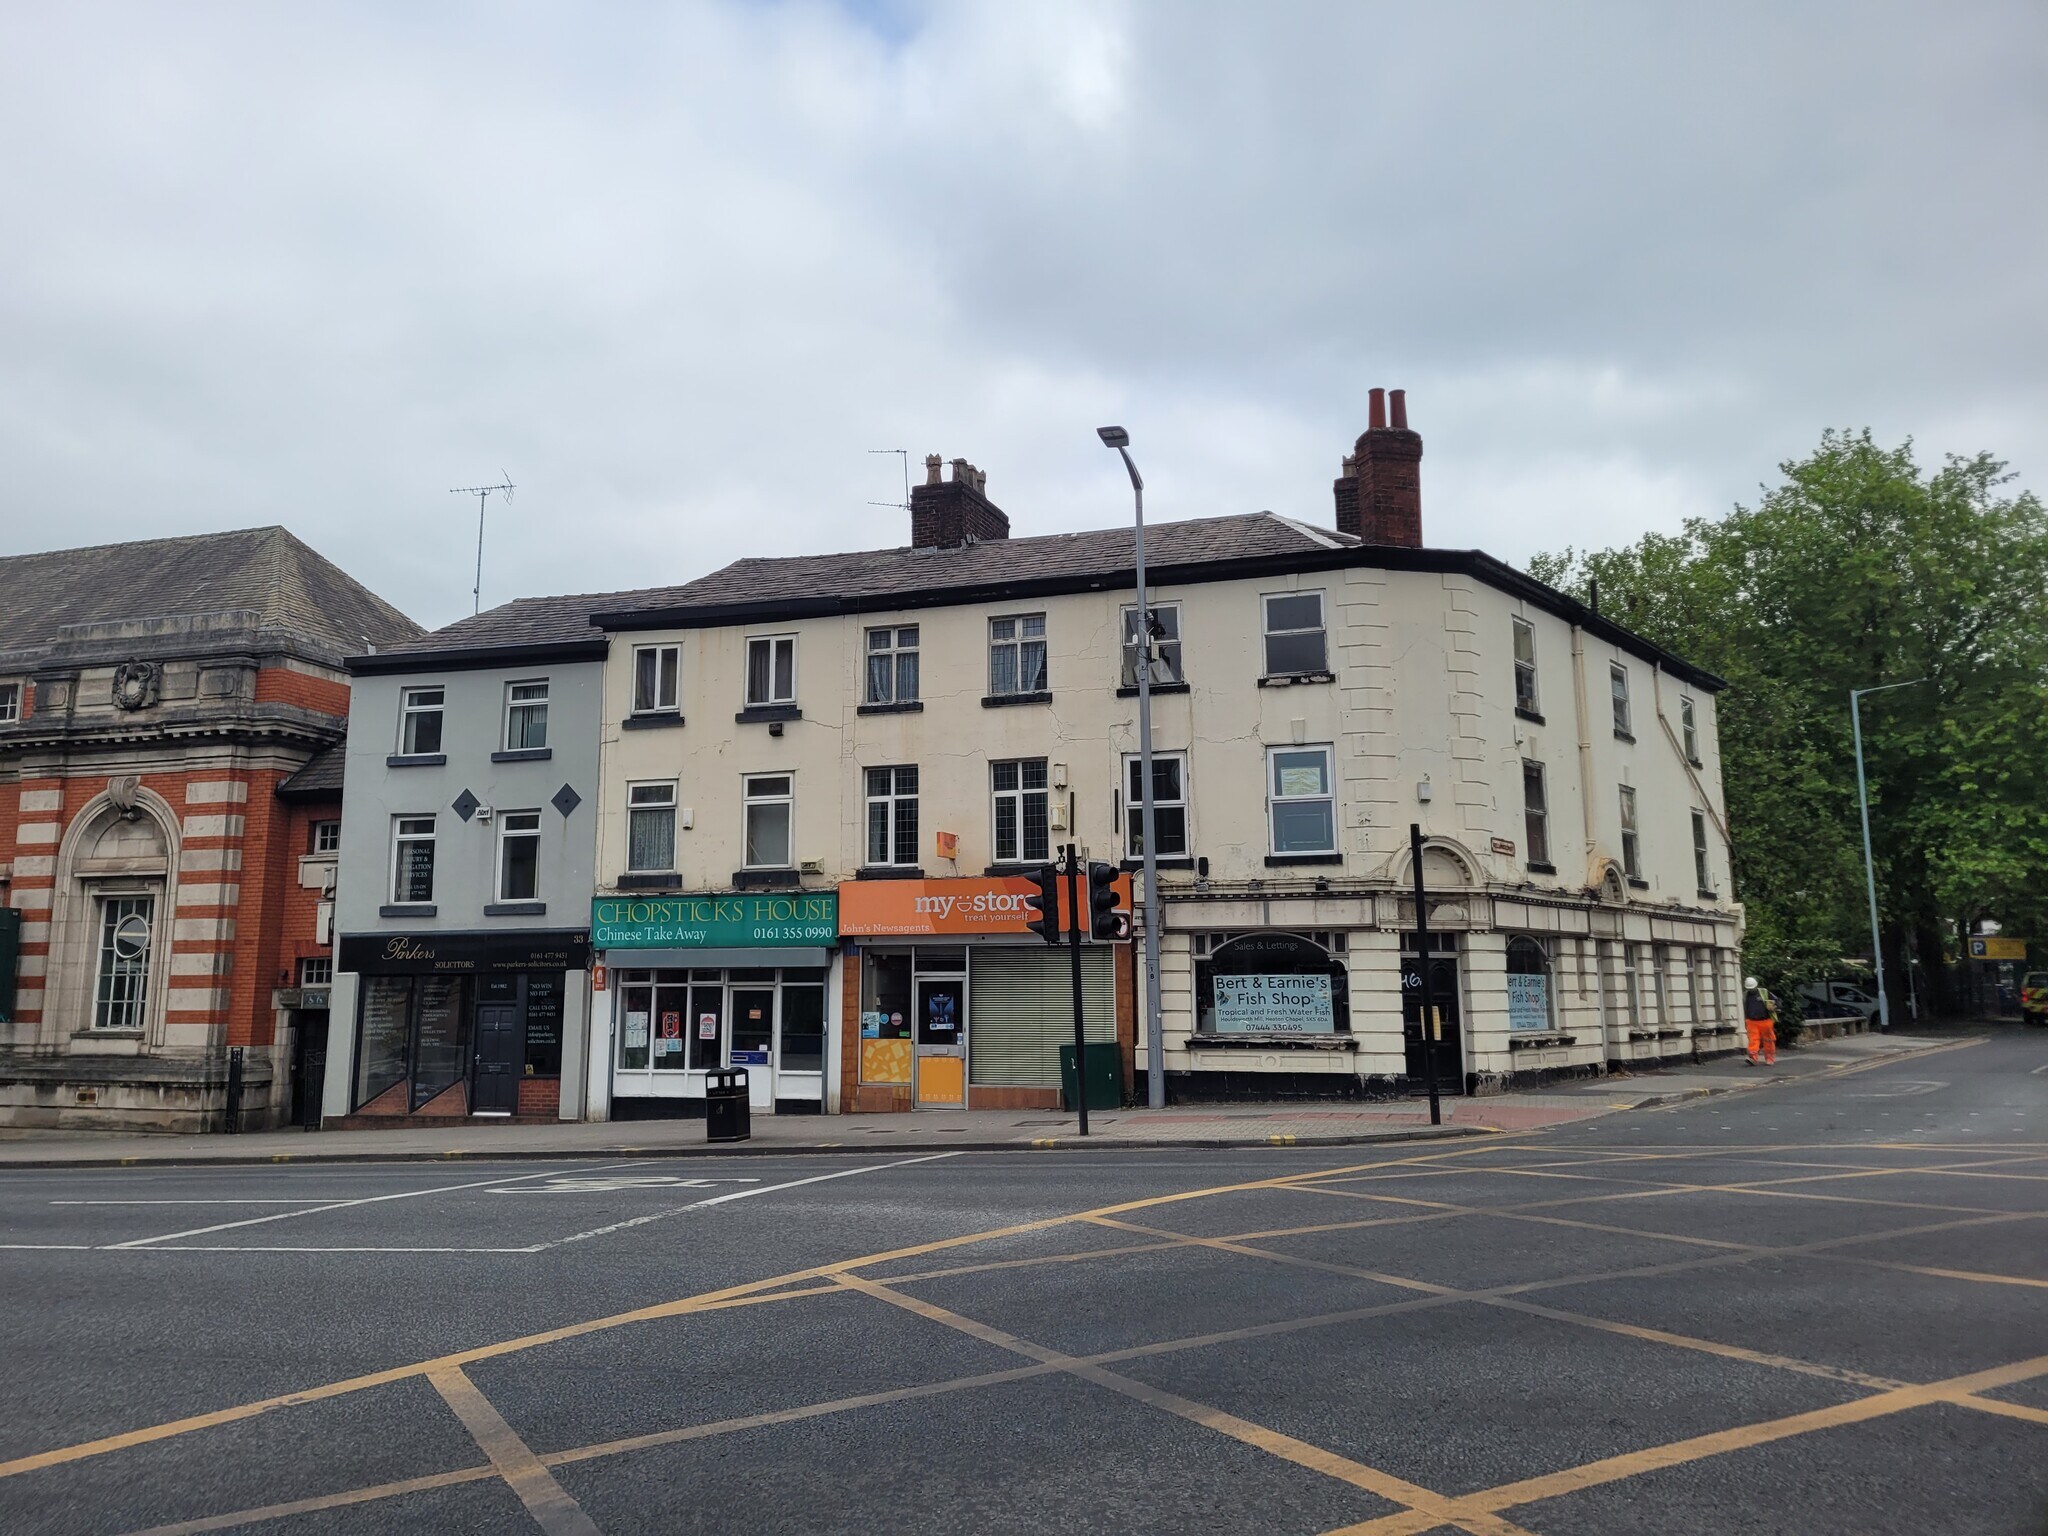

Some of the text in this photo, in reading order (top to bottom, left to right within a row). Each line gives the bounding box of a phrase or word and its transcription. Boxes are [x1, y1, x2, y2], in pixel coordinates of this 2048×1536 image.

[597, 899, 833, 924] CHOPSTICKS HOUSE
[965, 911, 1028, 922] treat yourself
[754, 926, 832, 938] 0161 355 0990
[841, 924, 930, 934] John's Newsagents
[573, 934, 584, 944] 33
[596, 926, 706, 944] Chinese Take Away
[382, 936, 435, 960] Parkers
[1234, 942, 1298, 951] Sales & Lettings
[530, 952, 568, 960] 0161 477 9451
[434, 960, 474, 968] SOLICITORS
[1216, 976, 1328, 989] Bert & Earnie's
[1238, 992, 1311, 1007] Fish Shop
[1512, 991, 1540, 1006] Fish Shop
[1218, 1008, 1248, 1018] Tropical
[1315, 1008, 1330, 1016] Fish
